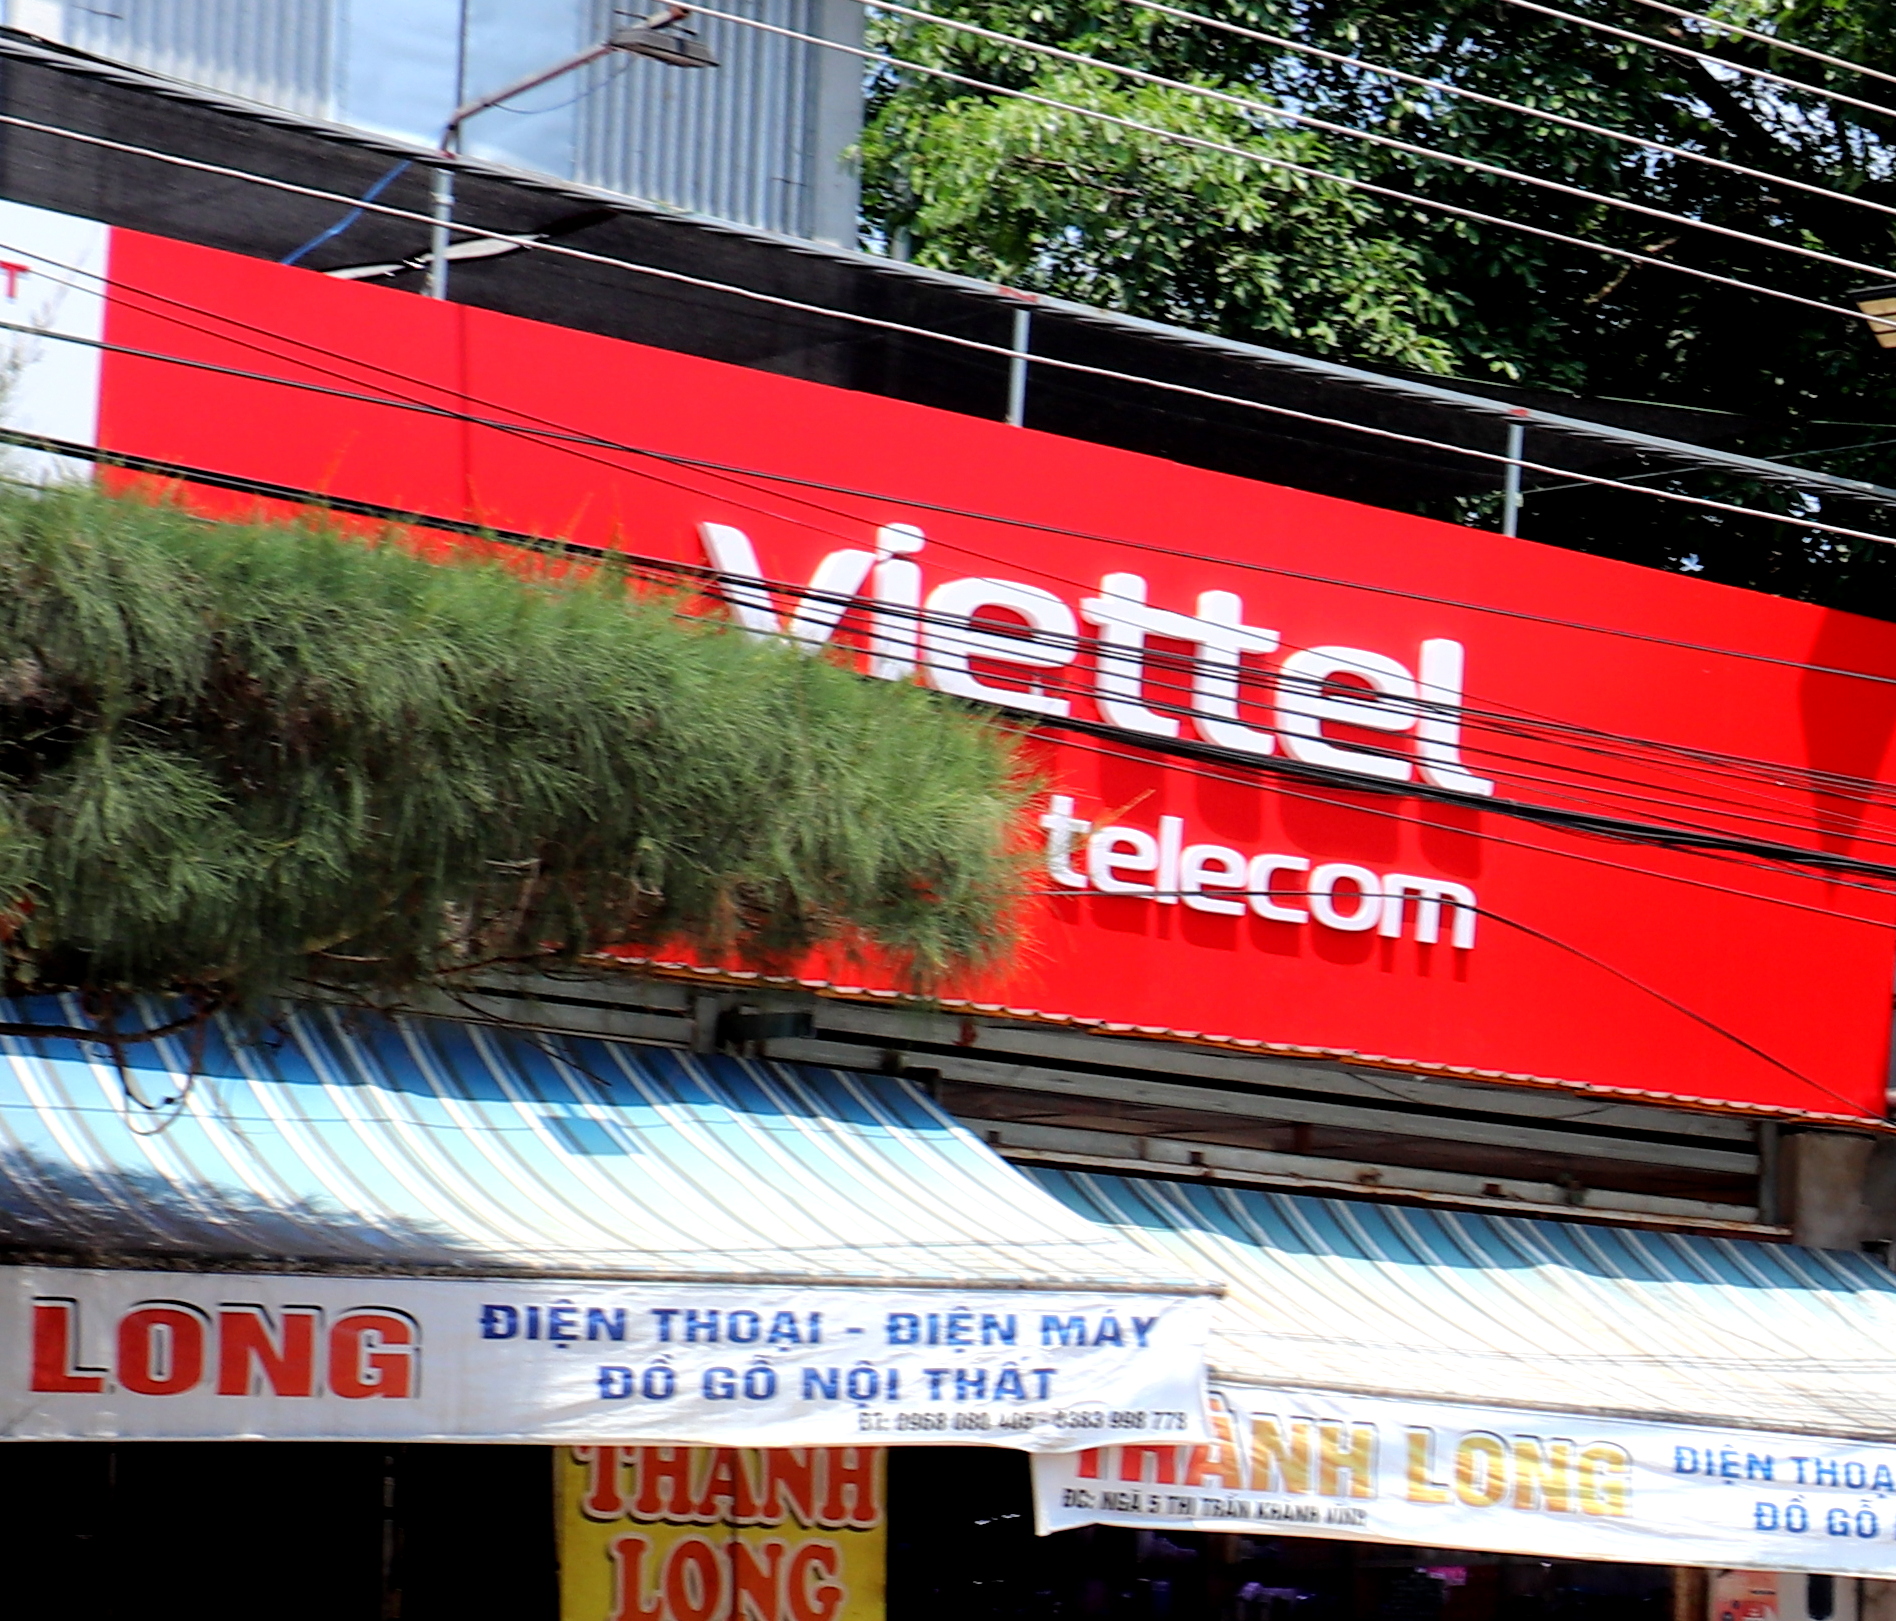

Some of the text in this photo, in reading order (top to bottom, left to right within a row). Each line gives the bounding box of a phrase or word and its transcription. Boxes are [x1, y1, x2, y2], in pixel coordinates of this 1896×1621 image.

[1039, 795, 1478, 949] telecom
[29, 1295, 422, 1400] LONG
[479, 1298, 626, 1349] ĐIỆN
[650, 1307, 823, 1352] THOẠI
[885, 1305, 1018, 1353] ĐIỆN
[1040, 1307, 1160, 1348] MÁY
[598, 1352, 1058, 1409] ĐỒ GỖ NỘI THẤT
[1404, 1424, 1633, 1518] LONG
[1673, 1443, 1775, 1485] ĐIỆN
[1753, 1494, 1809, 1534] ĐỒ
[1826, 1498, 1880, 1539] GỖ
